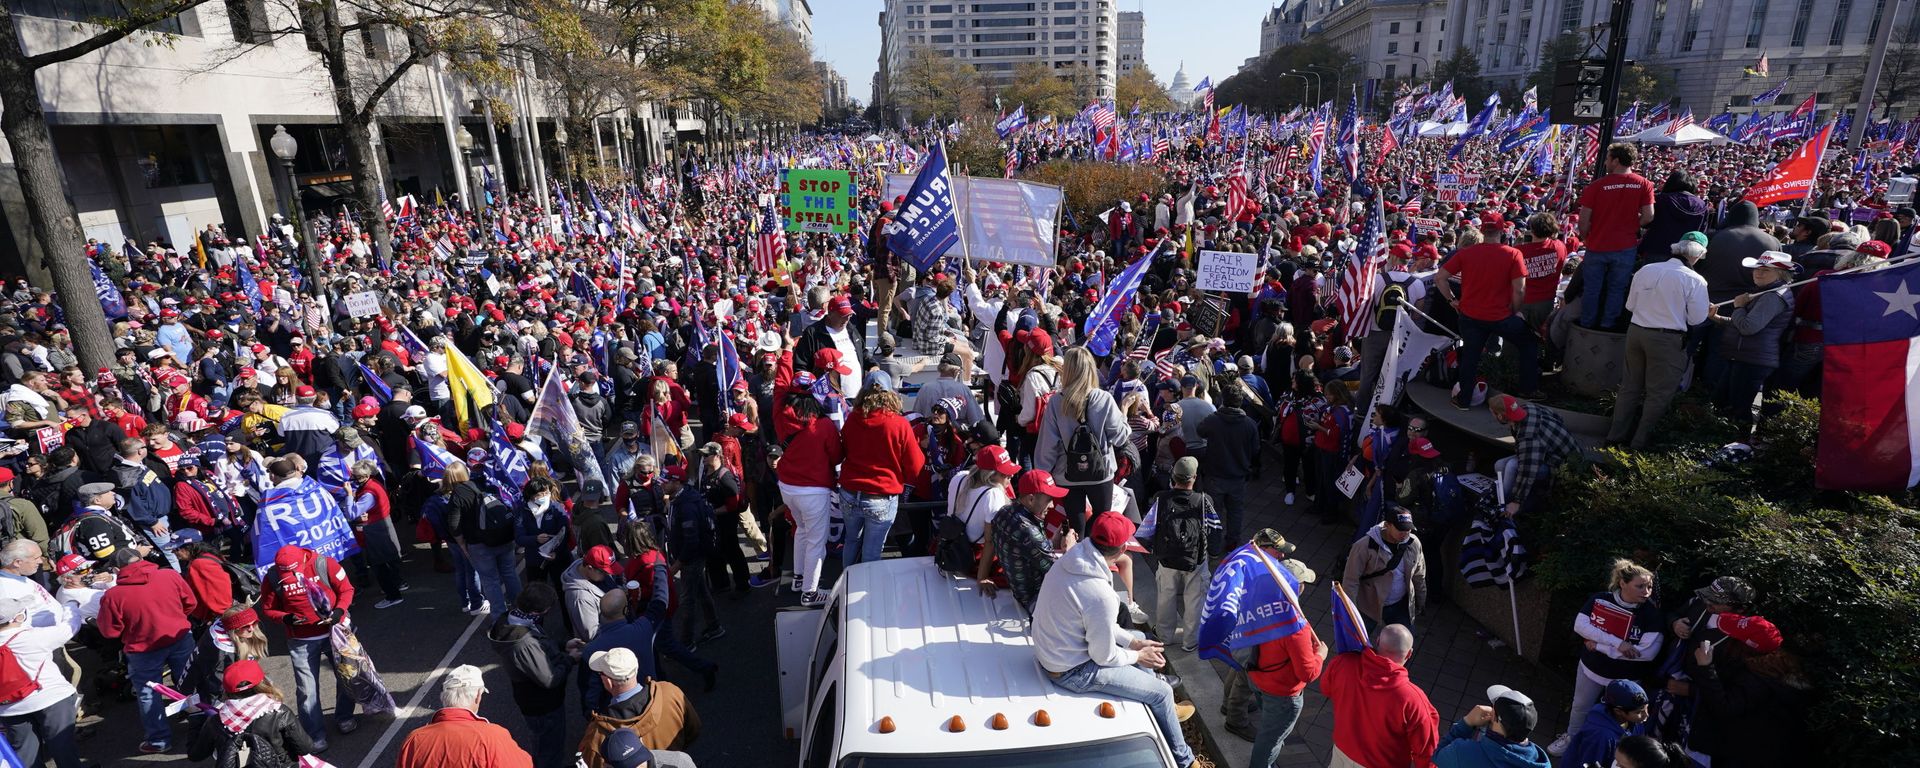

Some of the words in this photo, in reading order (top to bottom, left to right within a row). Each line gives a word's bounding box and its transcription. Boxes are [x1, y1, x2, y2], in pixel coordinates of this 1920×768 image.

[1440, 174, 1457, 183] PRES
[799, 179, 840, 192] STOP
[781, 169, 791, 229] TRUMP
[804, 195, 835, 209] THE
[848, 171, 857, 232] TRUMP
[1439, 190, 1458, 201] YOUR
[795, 212, 843, 225] STEAL
[1213, 254, 1242, 266] FAIR
[1203, 265, 1249, 276] ELECTION
[1209, 273, 1234, 281] REAL
[1205, 279, 1251, 291] RESULTS
[254, 487, 336, 536] TRUM
[89, 533, 111, 550] 95
[312, 536, 349, 555] ERICA
[283, 575, 320, 592] TRUP
